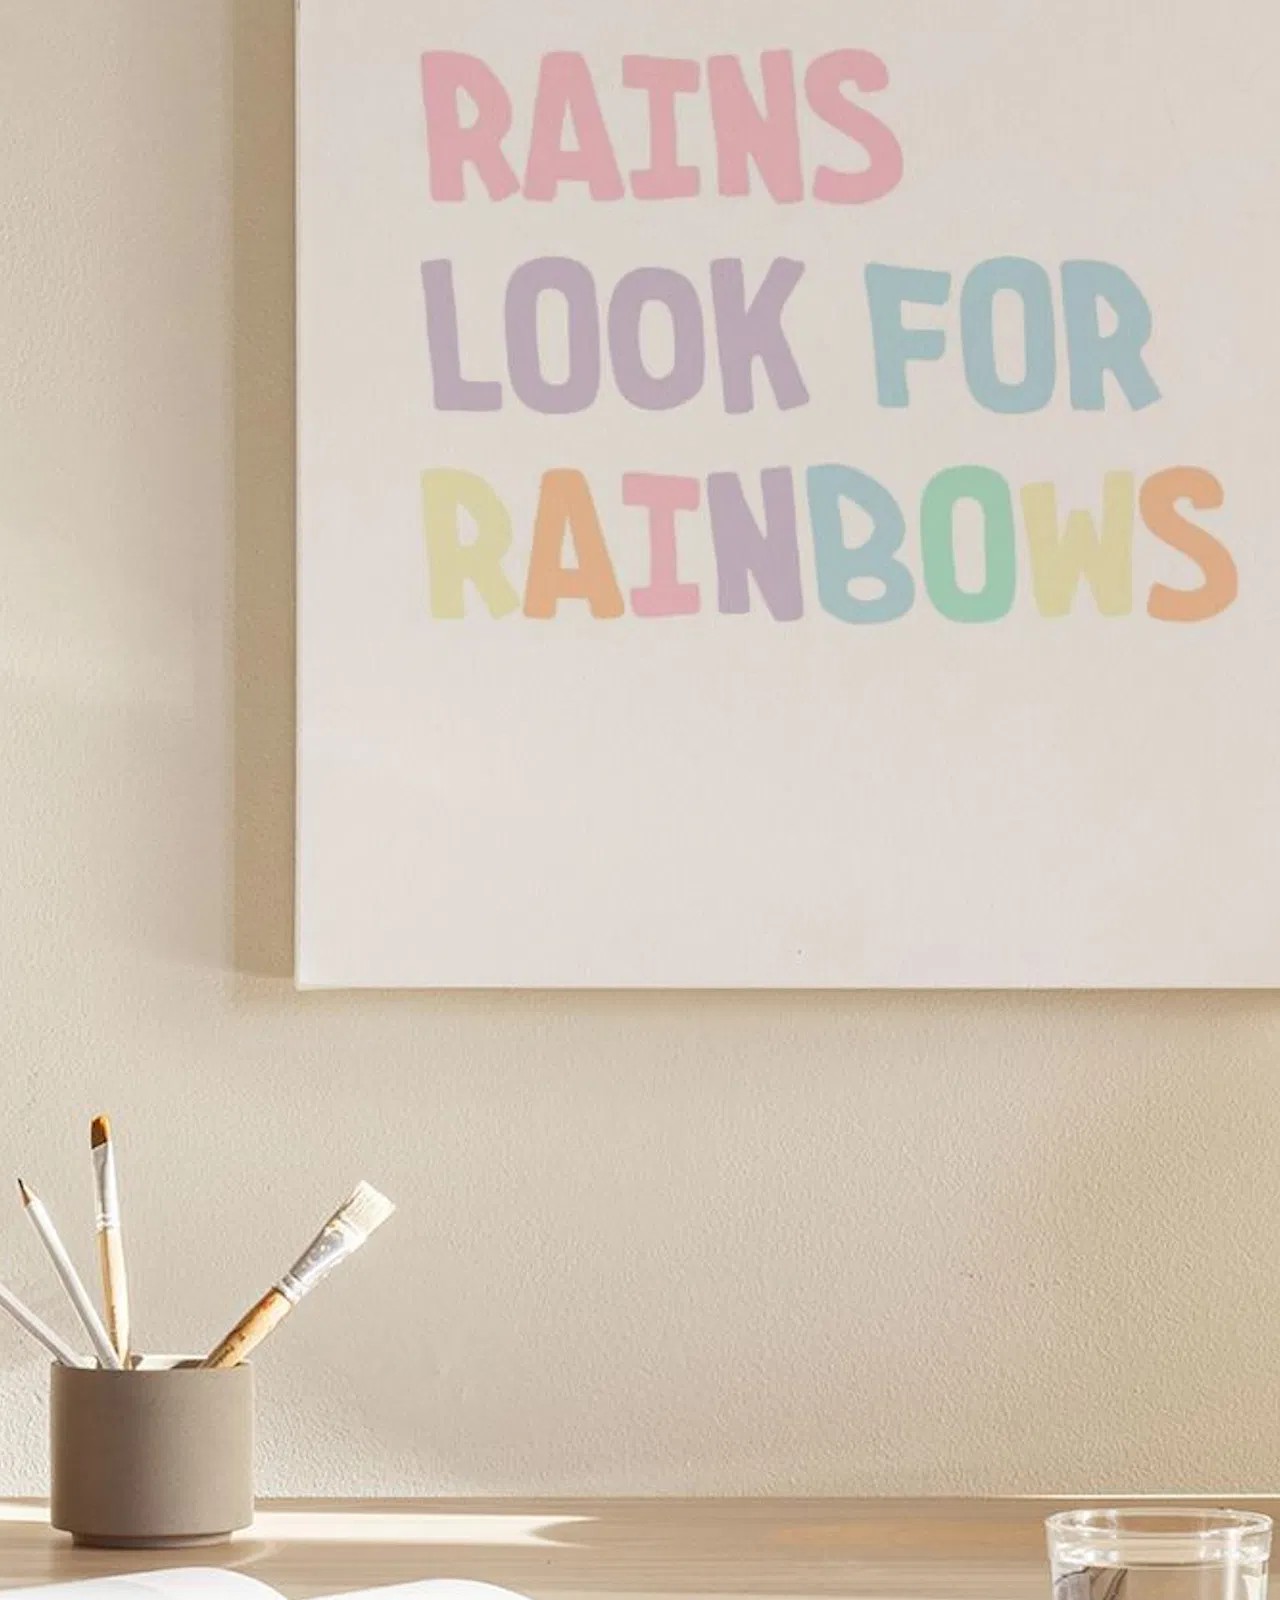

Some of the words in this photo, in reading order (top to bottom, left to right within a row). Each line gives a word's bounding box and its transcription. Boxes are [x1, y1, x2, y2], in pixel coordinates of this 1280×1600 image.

[419, 48, 904, 205] RAINS
[420, 256, 811, 416] LOOK
[864, 255, 1163, 416] FOR
[419, 463, 1239, 625] RAINBOWS
